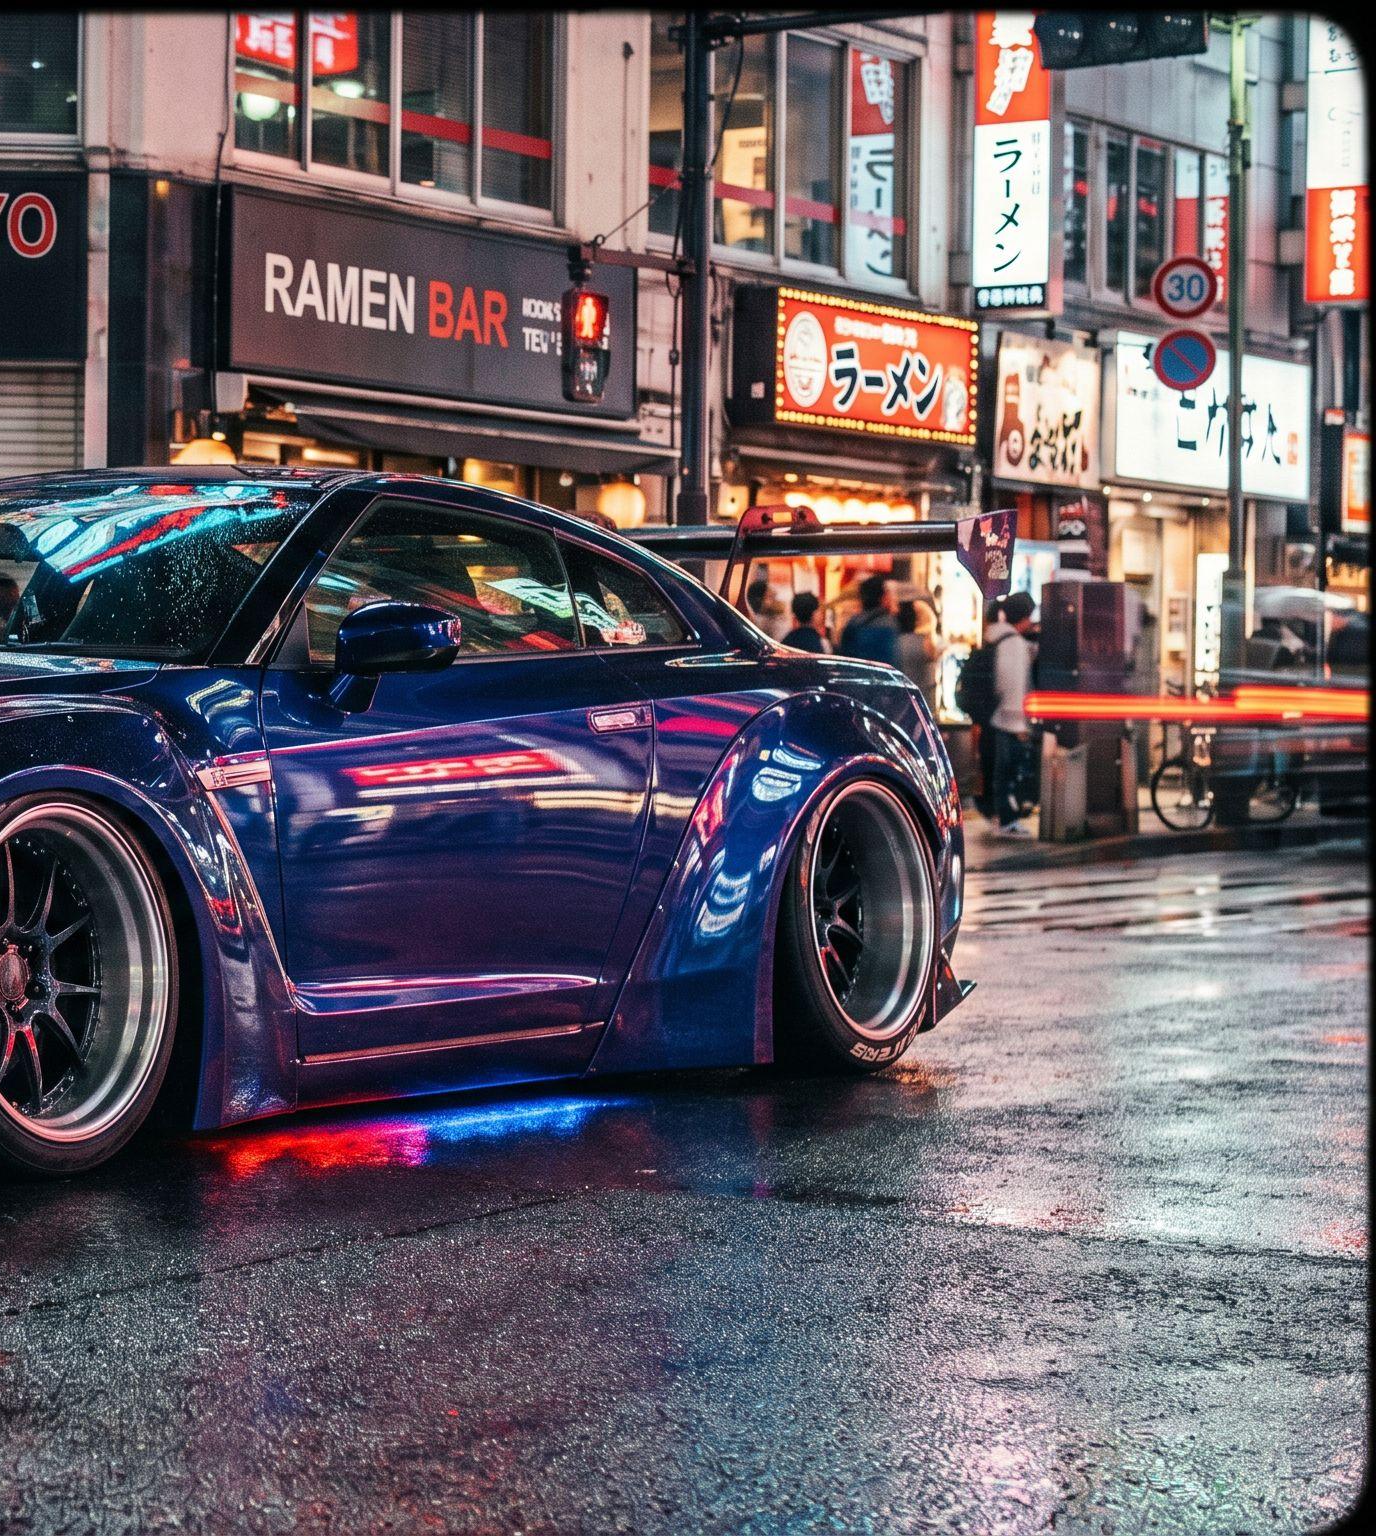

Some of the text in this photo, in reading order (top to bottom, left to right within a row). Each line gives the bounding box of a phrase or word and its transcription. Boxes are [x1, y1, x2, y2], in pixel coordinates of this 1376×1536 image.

[993, 138, 1023, 273] ラーメン
[264, 252, 510, 349] RAMEN BAR
[1167, 273, 1205, 302] 30
[830, 343, 942, 419] ラーメン
